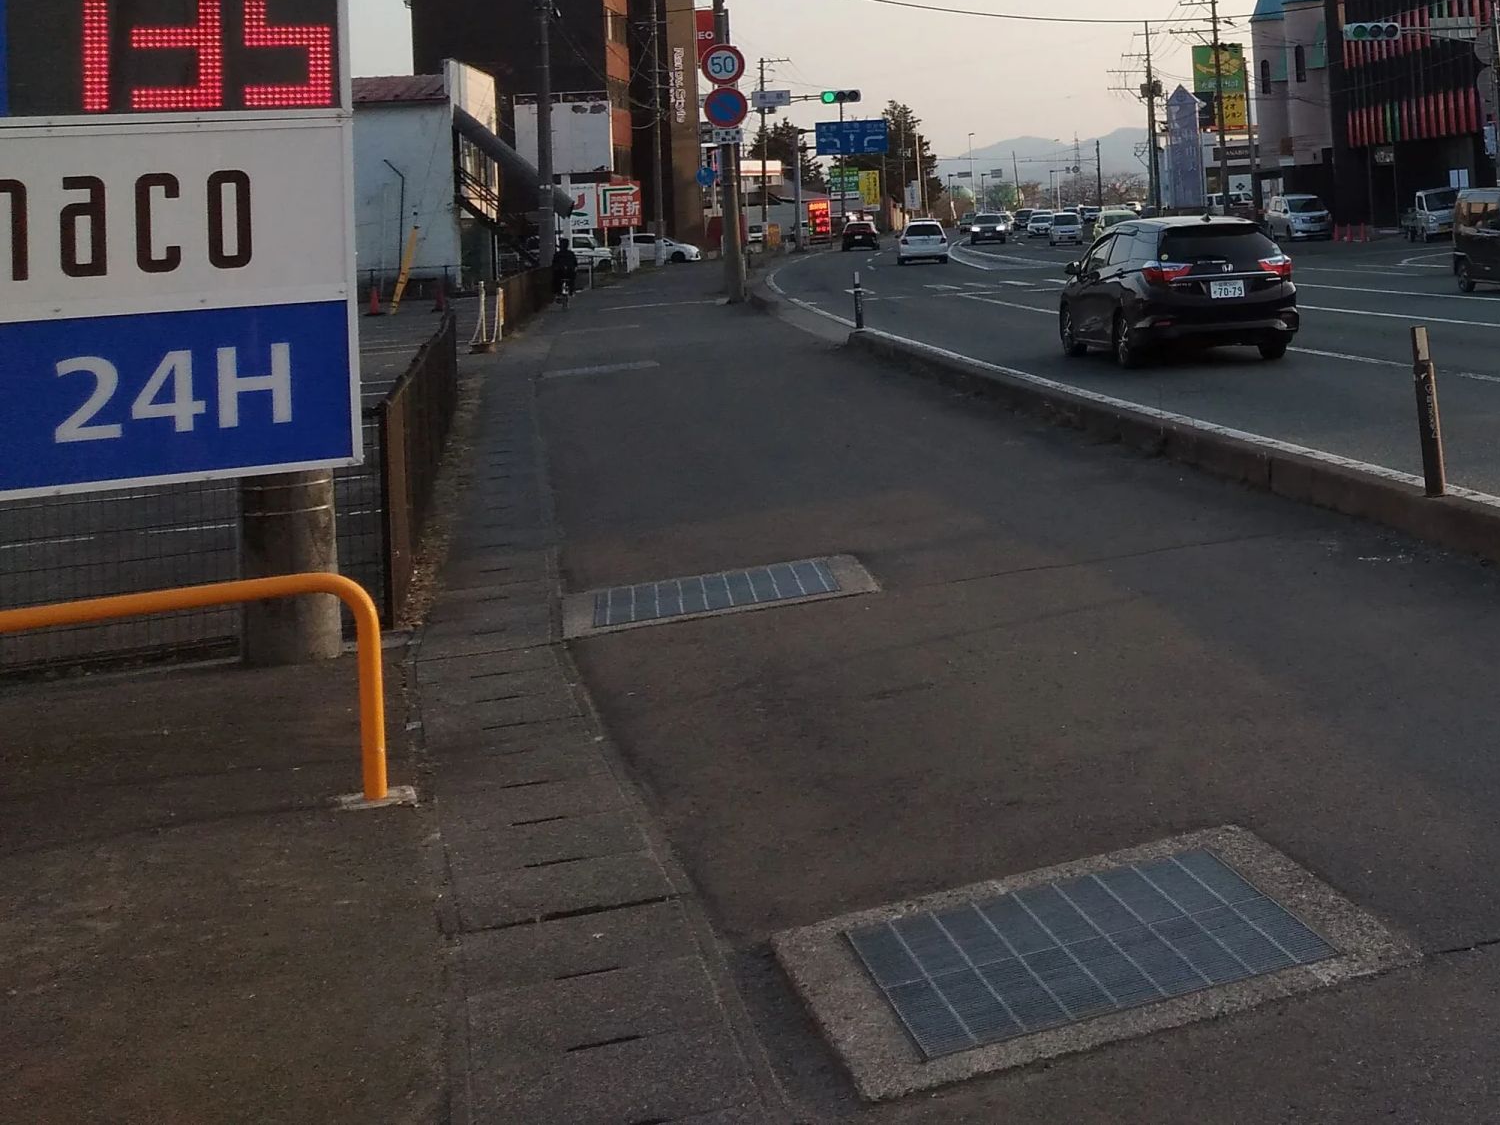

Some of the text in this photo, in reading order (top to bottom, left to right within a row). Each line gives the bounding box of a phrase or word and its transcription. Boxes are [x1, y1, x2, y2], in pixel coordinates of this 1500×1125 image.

[710, 55, 736, 75] 50
[610, 200, 640, 216] 右折
[55, 342, 292, 443] 24H
